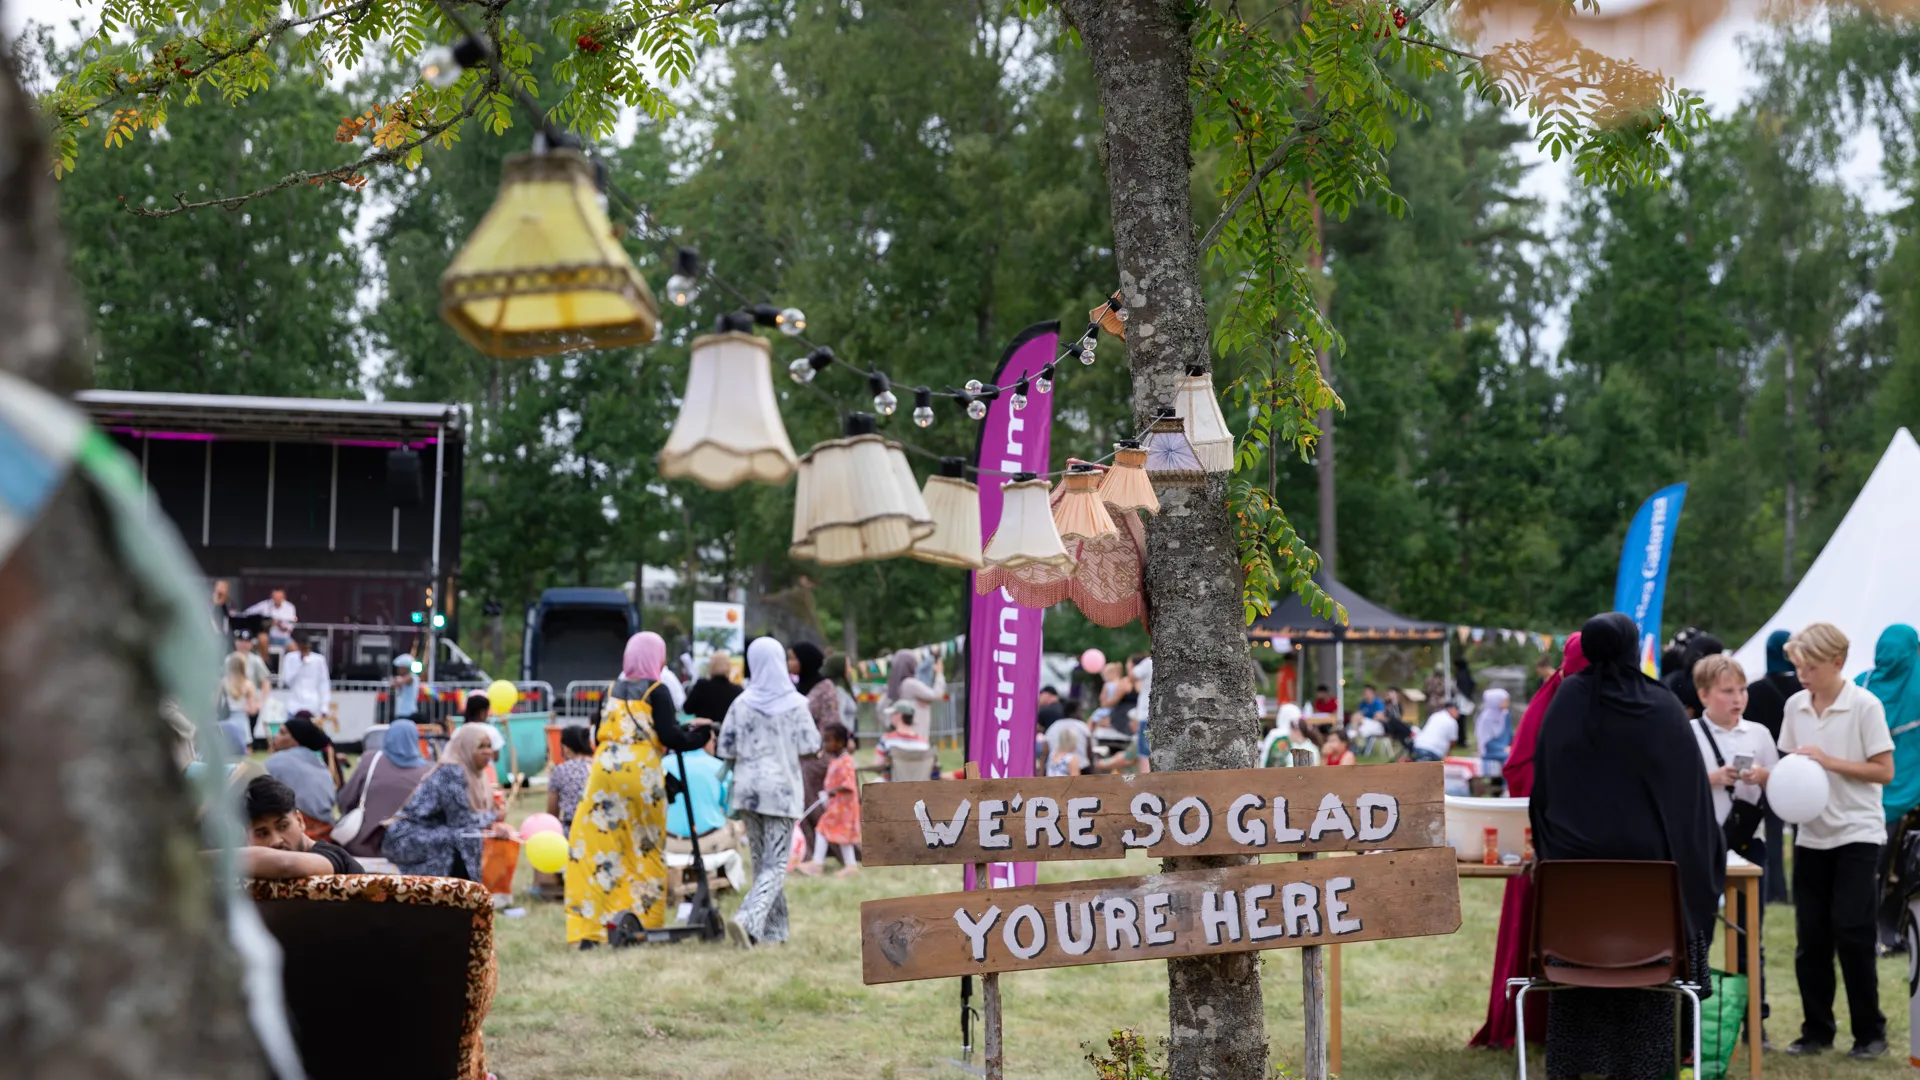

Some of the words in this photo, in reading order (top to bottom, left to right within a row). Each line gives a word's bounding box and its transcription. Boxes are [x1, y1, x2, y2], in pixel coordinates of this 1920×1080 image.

[914, 792, 1101, 849] WE'RE
[1122, 792, 1213, 847] SO
[1226, 793, 1399, 846] GLAD
[954, 892, 1176, 962] YOU'RE
[1201, 877, 1362, 945] HERE
